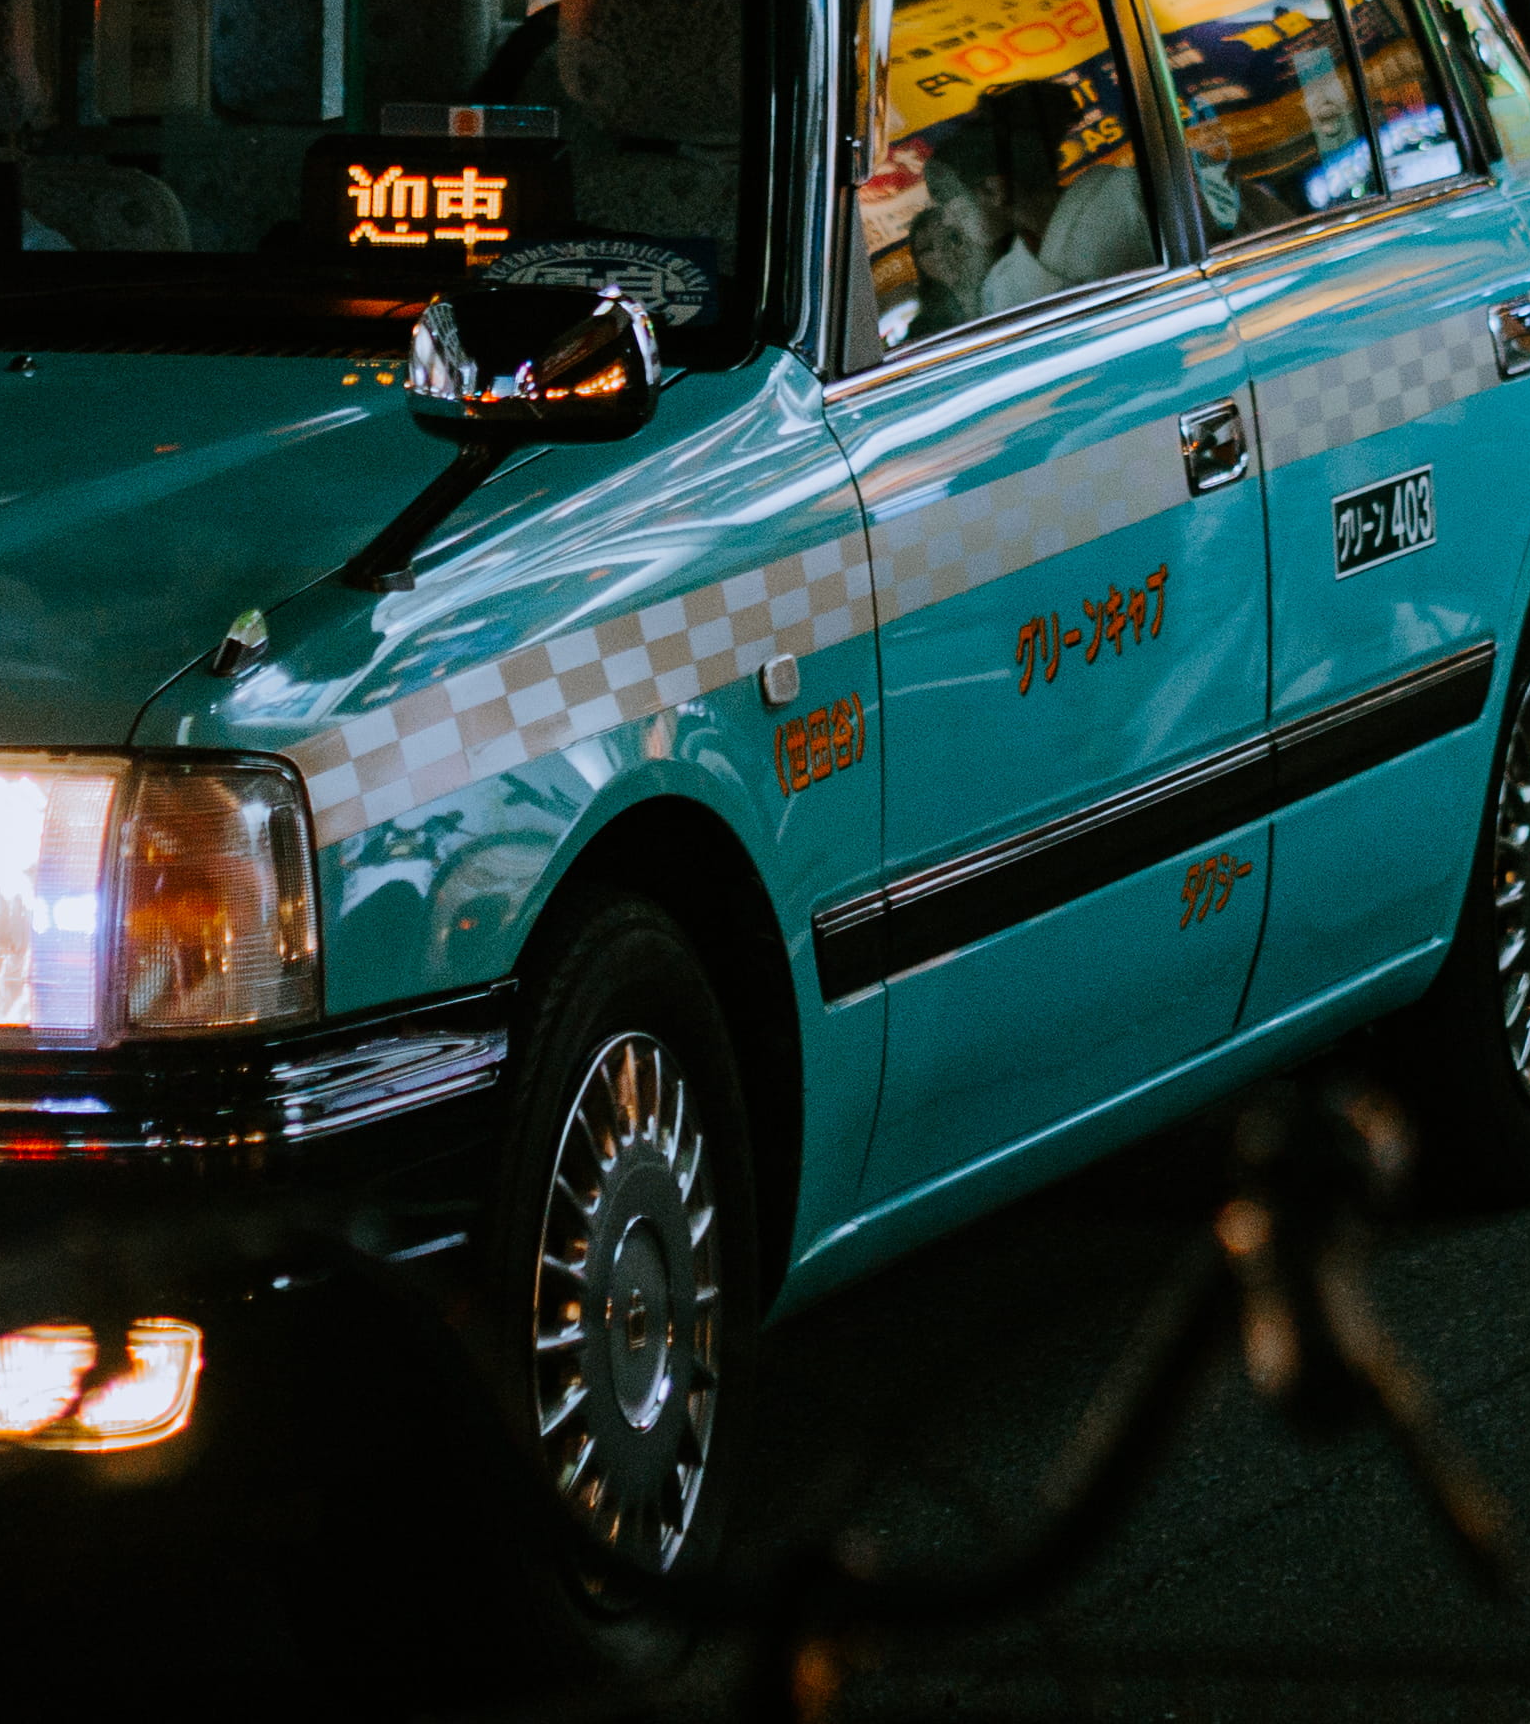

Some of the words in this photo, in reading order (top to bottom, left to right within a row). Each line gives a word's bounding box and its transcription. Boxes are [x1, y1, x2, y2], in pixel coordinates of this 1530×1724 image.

[347, 164, 510, 246] 迎車
[1336, 500, 1388, 565] グリーン
[1390, 475, 1432, 544] 403
[1016, 563, 1172, 697] グリーンキャブ
[1180, 853, 1254, 930] タクシー
